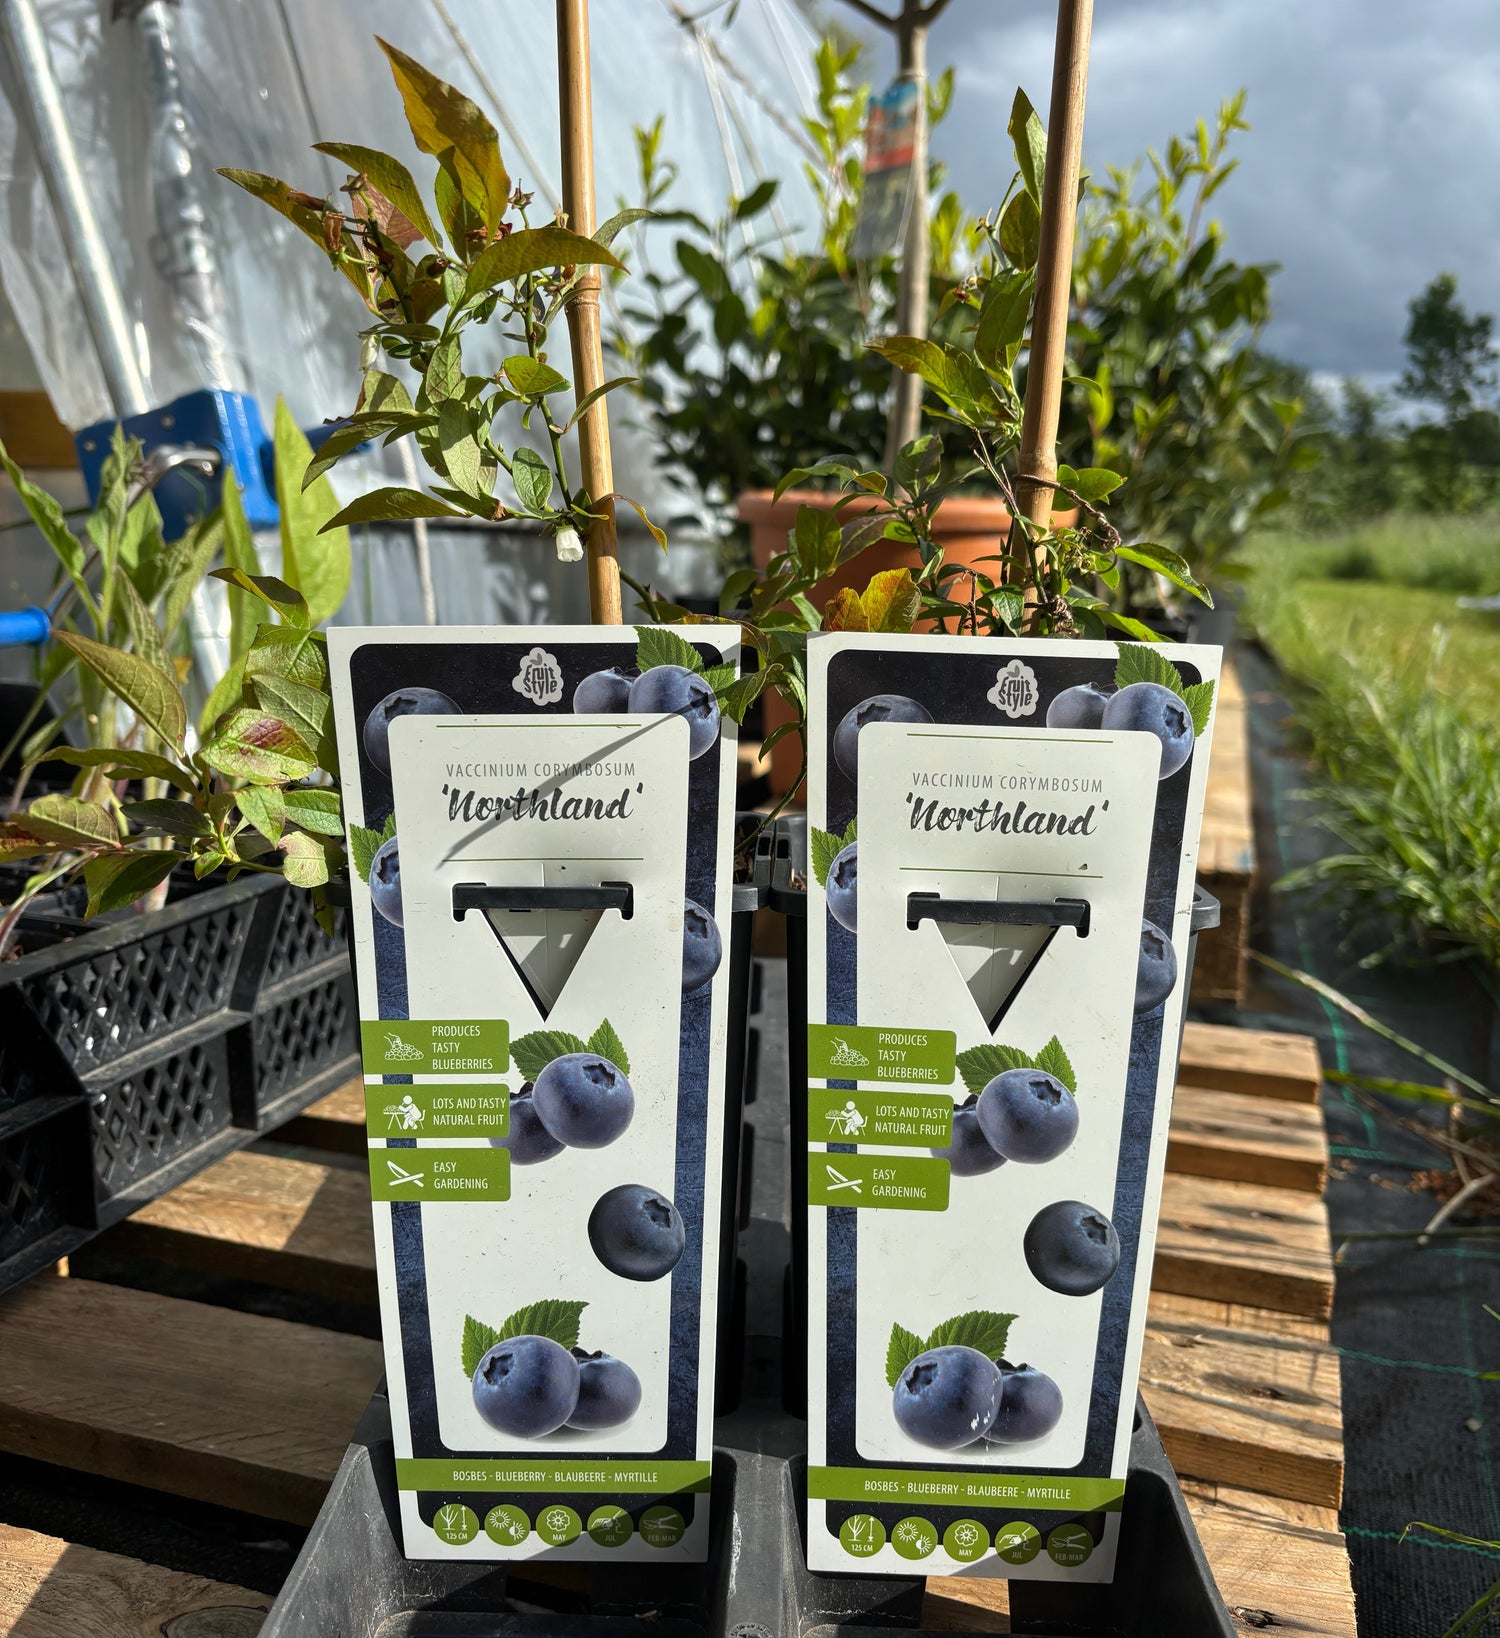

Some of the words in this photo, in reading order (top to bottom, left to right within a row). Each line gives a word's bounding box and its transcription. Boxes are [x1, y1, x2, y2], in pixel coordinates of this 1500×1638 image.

[524, 663, 555, 681] Fruit
[523, 679, 557, 699] Style
[1001, 675, 1031, 694] Fruit
[998, 690, 1032, 711] Style
[446, 763, 528, 778] VACCINIUM
[534, 762, 636, 777] CORYMBOSUM
[912, 773, 994, 789] VACCINIUM
[1000, 775, 1103, 794] CORYMBOSUM
[432, 1025, 481, 1037] PRODUCES
[879, 1033, 927, 1046] PRODUCES
[432, 1042, 460, 1053] TASTY
[878, 1050, 907, 1062] TASTY
[432, 1058, 493, 1070] BLUEBERRIES
[877, 1067, 939, 1080] BLUEBERRIES
[432, 1098, 454, 1109] LOTS
[456, 1098, 477, 1109] AND
[478, 1098, 506, 1109] TASTY
[875, 1105, 897, 1117] LOTS
[899, 1107, 920, 1118] AND
[921, 1107, 950, 1120] TASTY
[433, 1114, 475, 1126] NATURAL
[477, 1114, 504, 1125] FRUIT
[875, 1122, 917, 1135] NATURAL
[920, 1124, 946, 1136] FRUIT
[434, 1162, 457, 1173] EASY
[873, 1168, 896, 1181] EASY
[434, 1178, 488, 1189] GARDENING
[872, 1185, 927, 1198] GARDENING
[453, 1471, 487, 1481] BOSBES
[495, 1471, 546, 1482] BLUEBERRY
[554, 1472, 606, 1482] BLAUBEERE
[614, 1472, 658, 1483] MYRTILLE
[865, 1480, 899, 1492] BOSBES
[907, 1482, 959, 1495] BLUEBERRY
[967, 1485, 1018, 1497] BLAUBEERE
[1027, 1487, 1071, 1499] MYRTILLE
[605, 1534, 616, 1542] JUL
[851, 1544, 862, 1552] 125
[863, 1544, 873, 1552] CM
[958, 1548, 973, 1557] MAY
[1011, 1551, 1023, 1559] JUL
[1055, 1553, 1083, 1562] FEB-MAR
